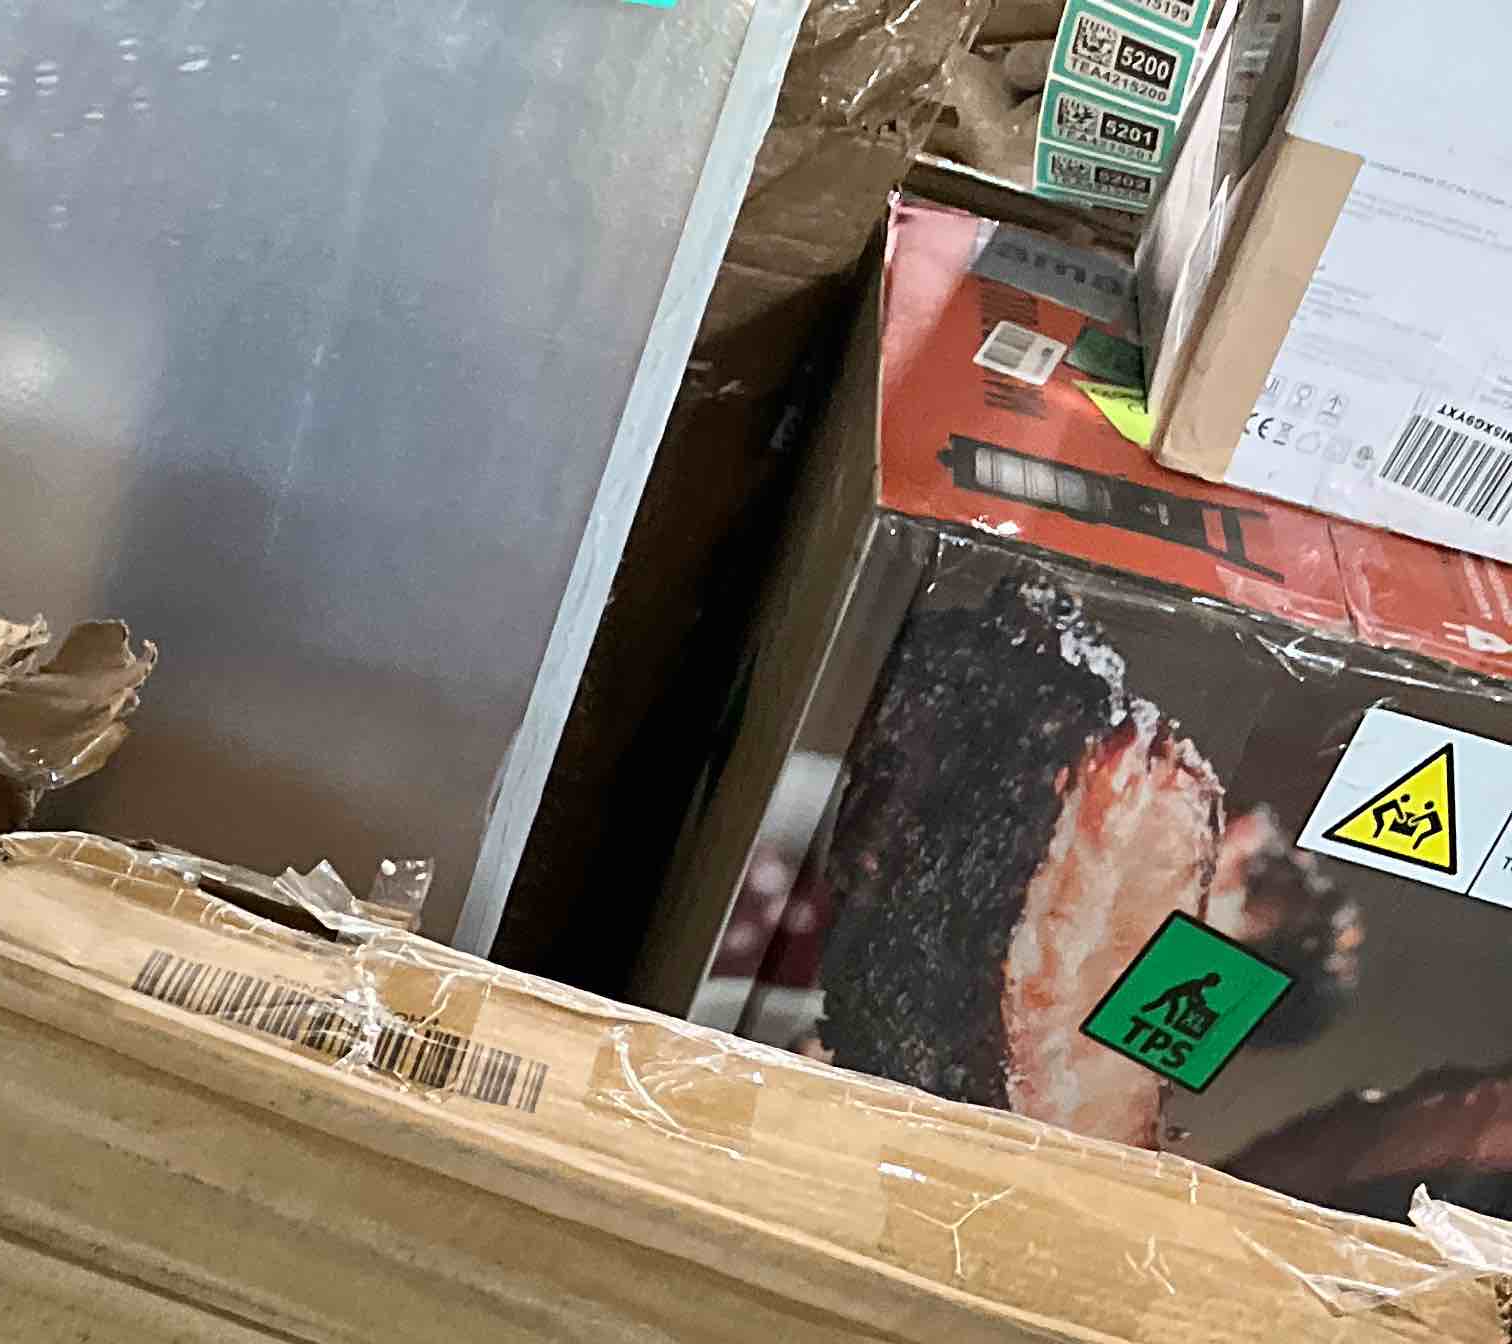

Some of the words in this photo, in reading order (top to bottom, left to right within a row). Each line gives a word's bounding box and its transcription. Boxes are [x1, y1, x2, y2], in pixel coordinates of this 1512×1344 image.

[1120, 46, 1171, 81] 5200
[1104, 119, 1154, 146] 5201
[1121, 1015, 1195, 1072] TPS
